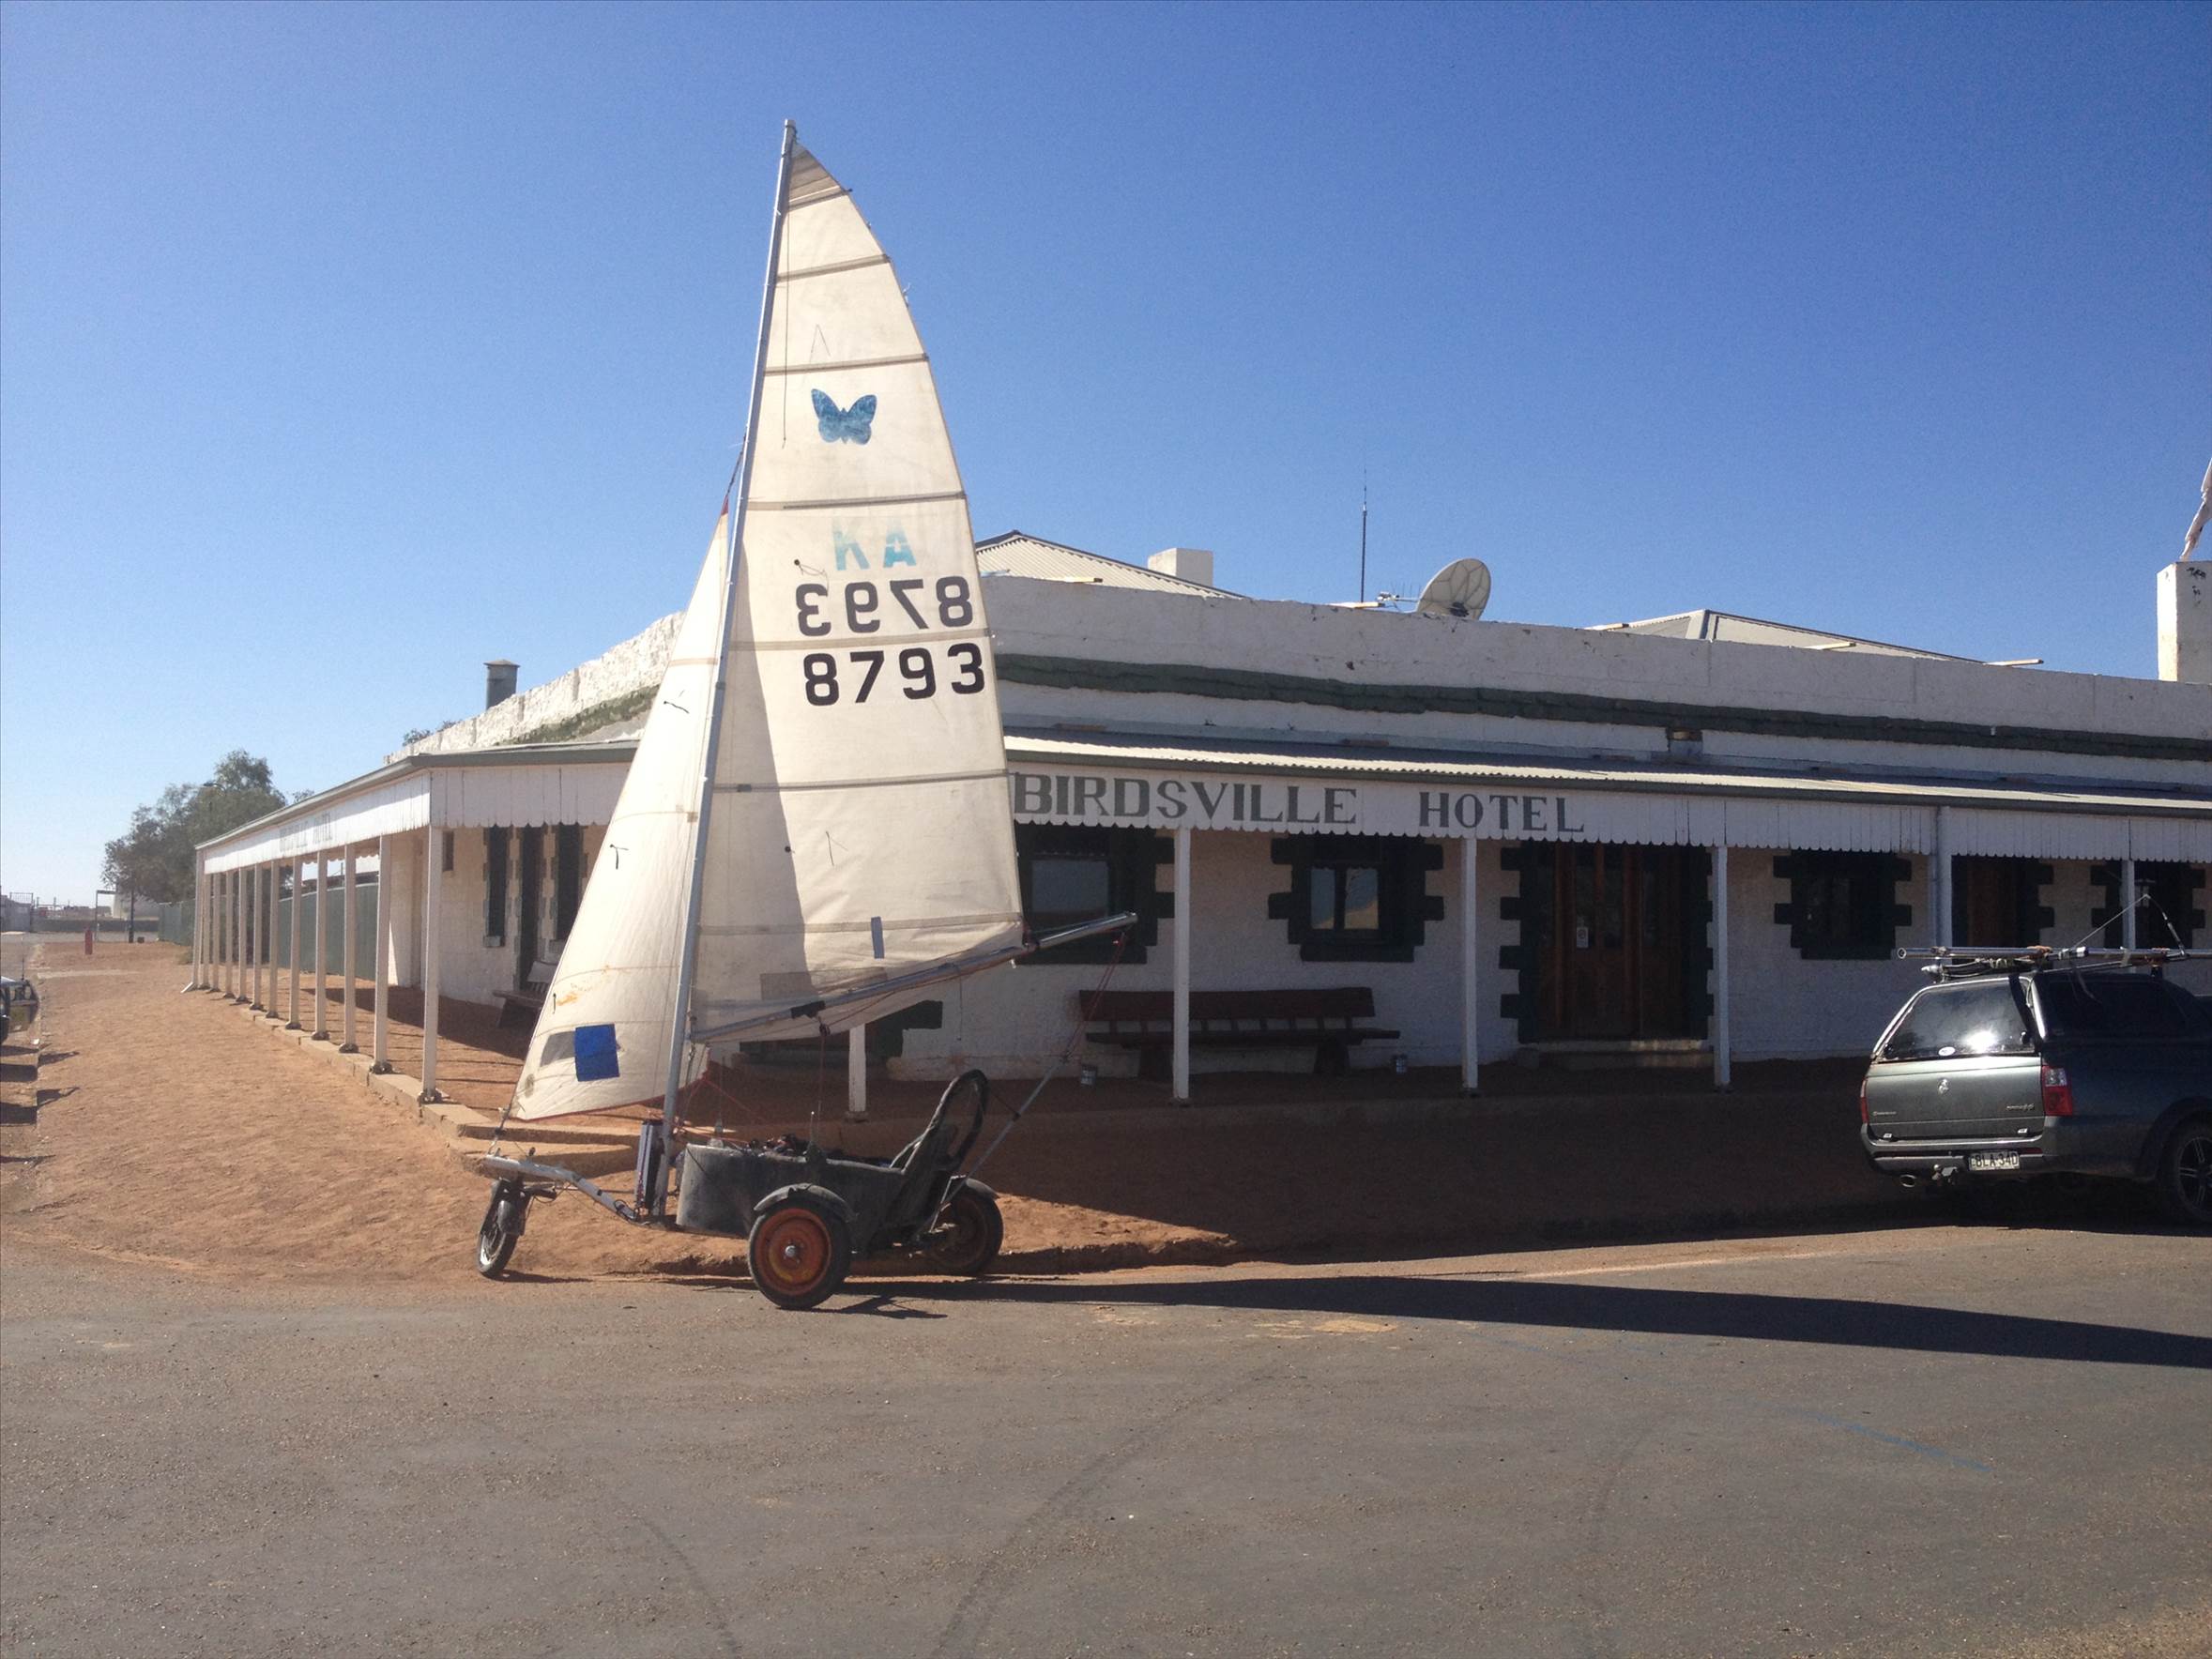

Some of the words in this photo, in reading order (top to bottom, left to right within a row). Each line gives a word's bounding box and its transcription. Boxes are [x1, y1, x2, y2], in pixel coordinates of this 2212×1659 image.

[832, 515, 917, 571] KA
[803, 642, 985, 707] 8793
[1014, 774, 1357, 823] BIRDSVILLE
[1419, 791, 1585, 833] HOTEL
